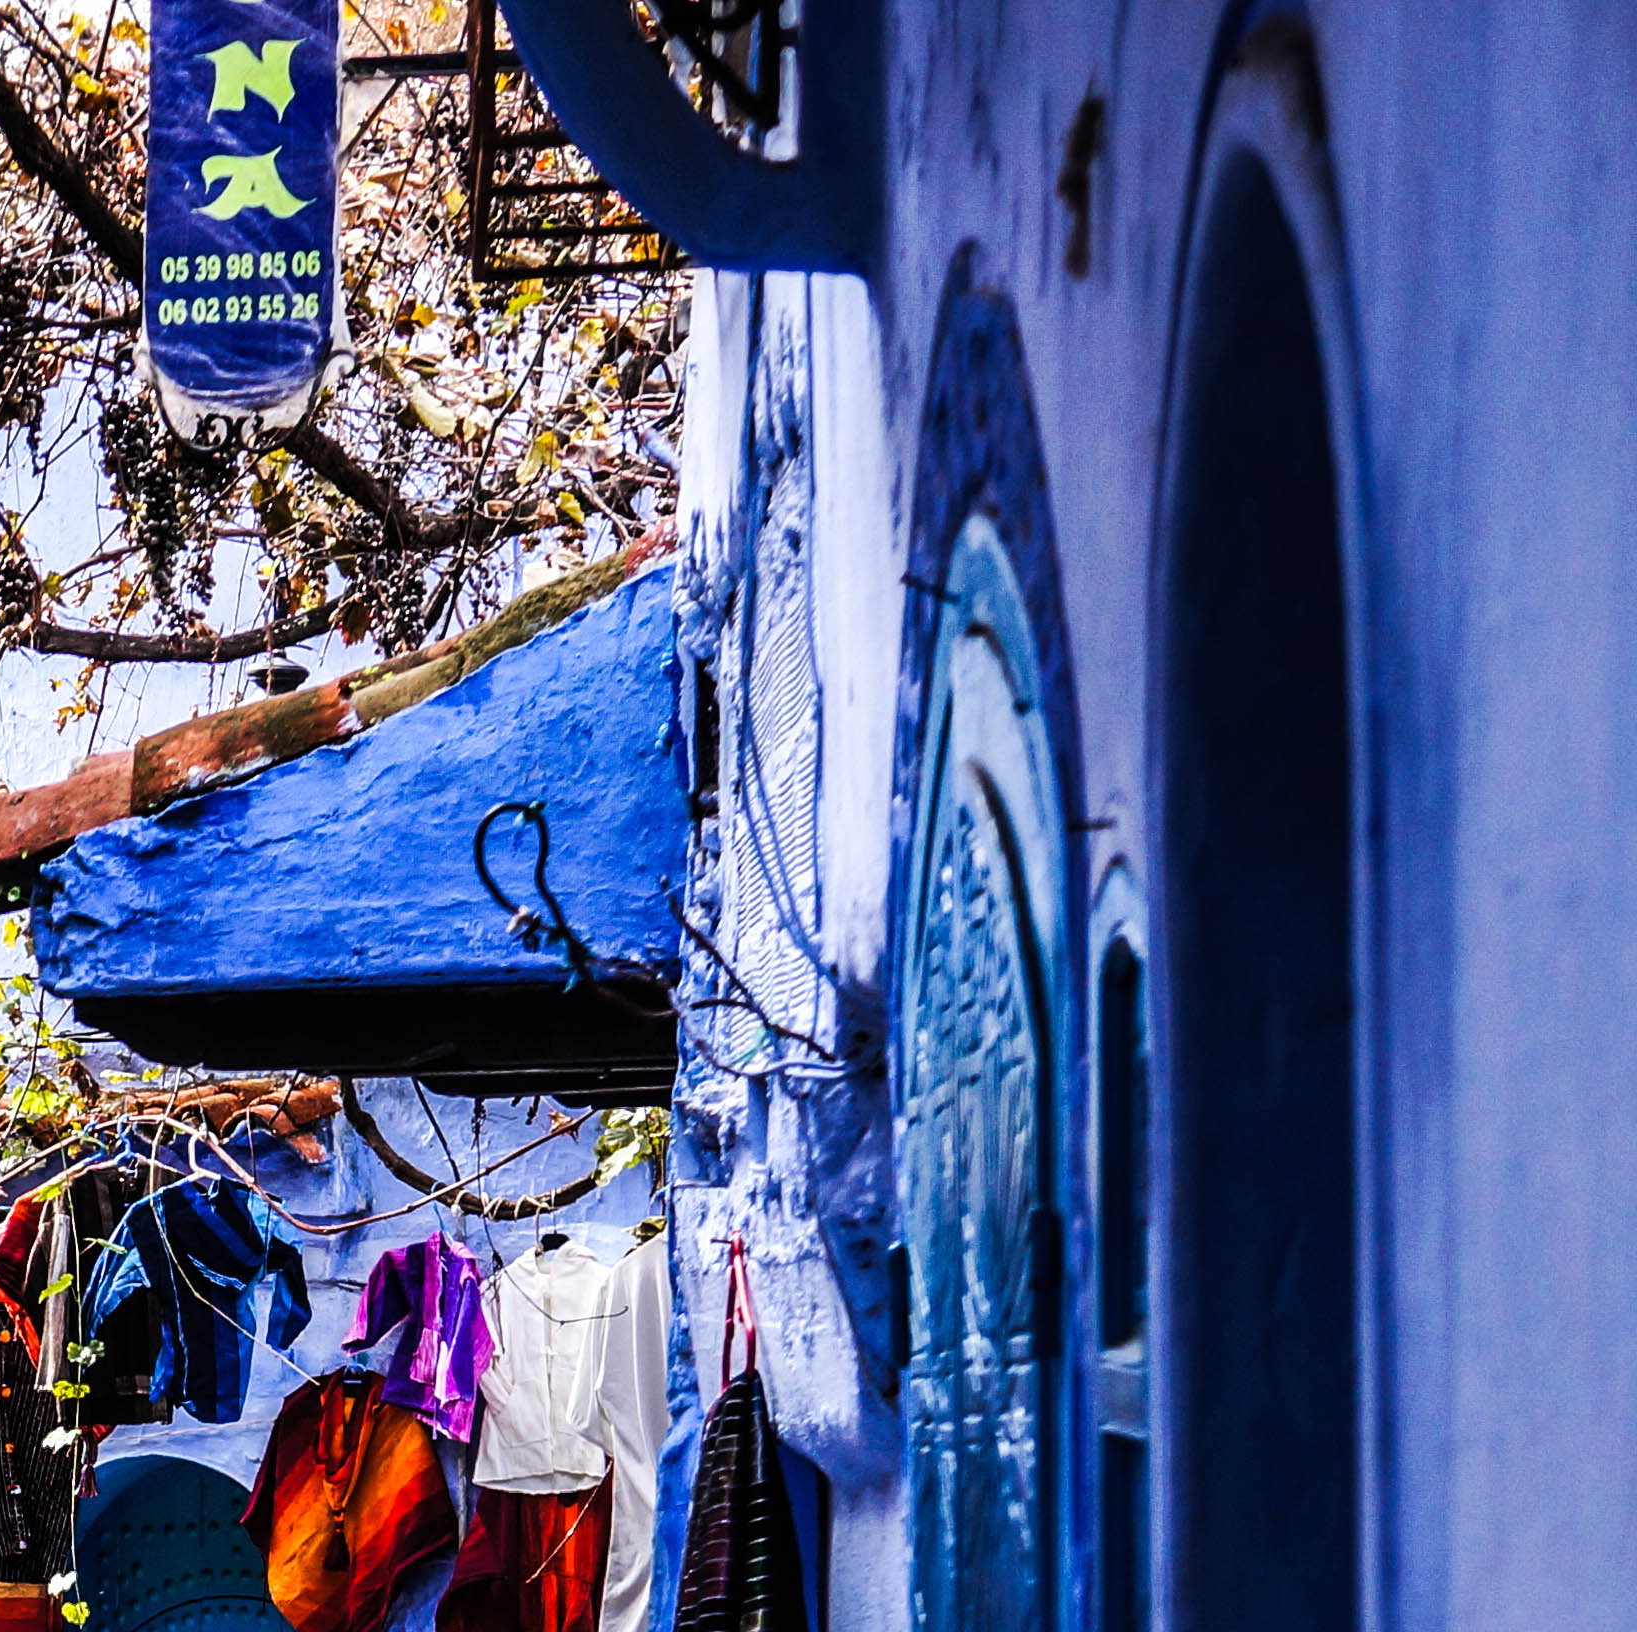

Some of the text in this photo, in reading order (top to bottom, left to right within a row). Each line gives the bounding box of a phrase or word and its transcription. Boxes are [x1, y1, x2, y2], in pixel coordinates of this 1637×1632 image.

[161, 250, 321, 283] 05 39 98 85 06
[159, 292, 319, 325] 06 02 93 55 26
